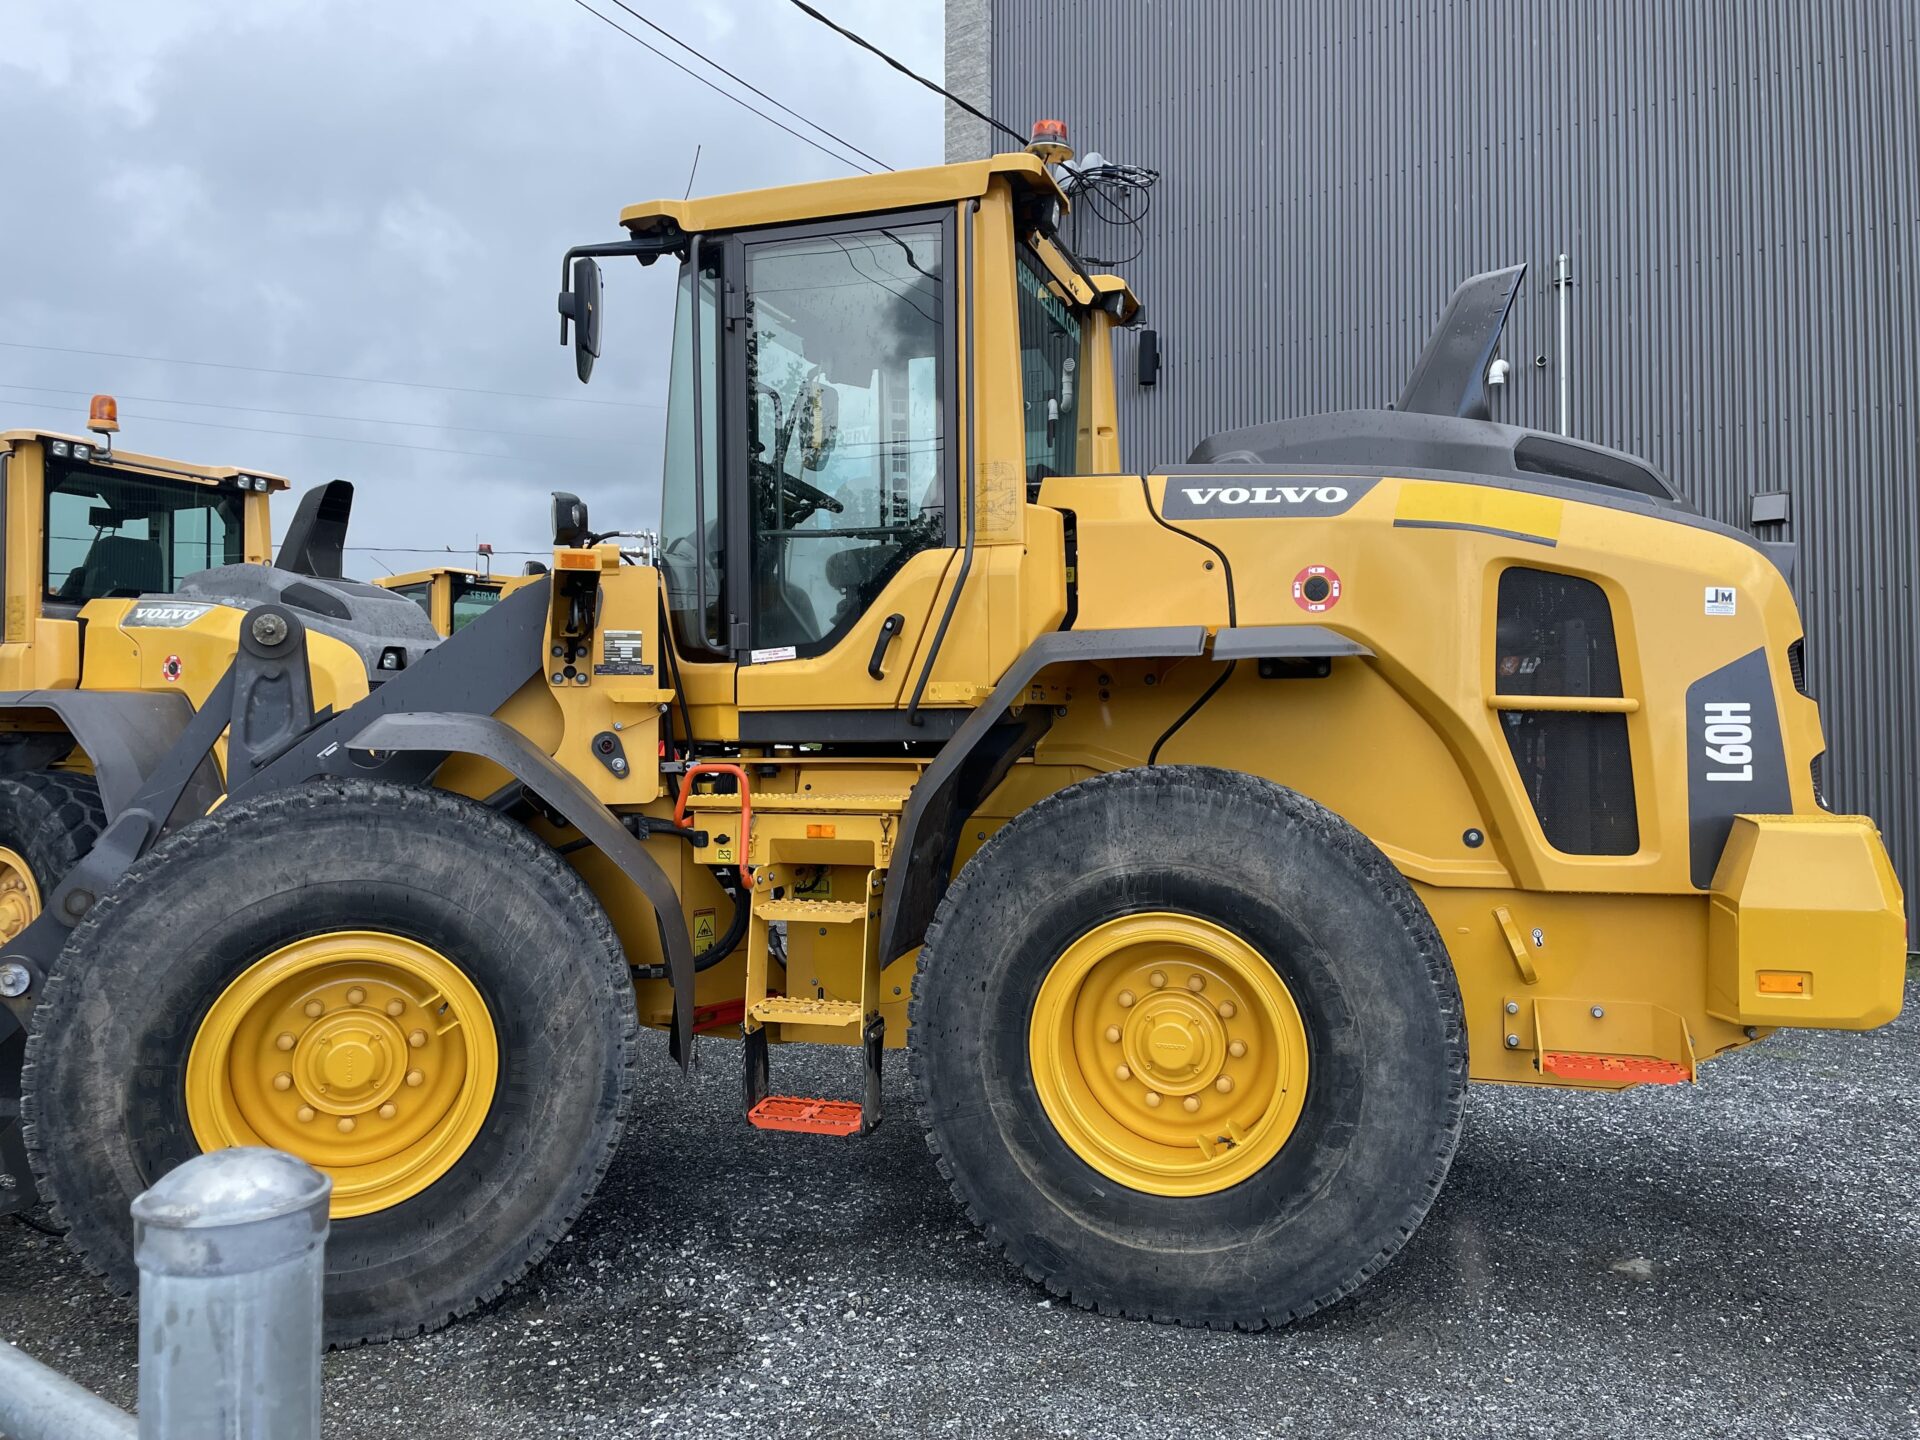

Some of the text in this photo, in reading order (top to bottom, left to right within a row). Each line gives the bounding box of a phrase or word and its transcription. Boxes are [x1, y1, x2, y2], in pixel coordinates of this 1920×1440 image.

[1181, 486, 1349, 505] VOLVO
[135, 607, 199, 620] VOLVO
[1704, 702, 1753, 782] L60H
